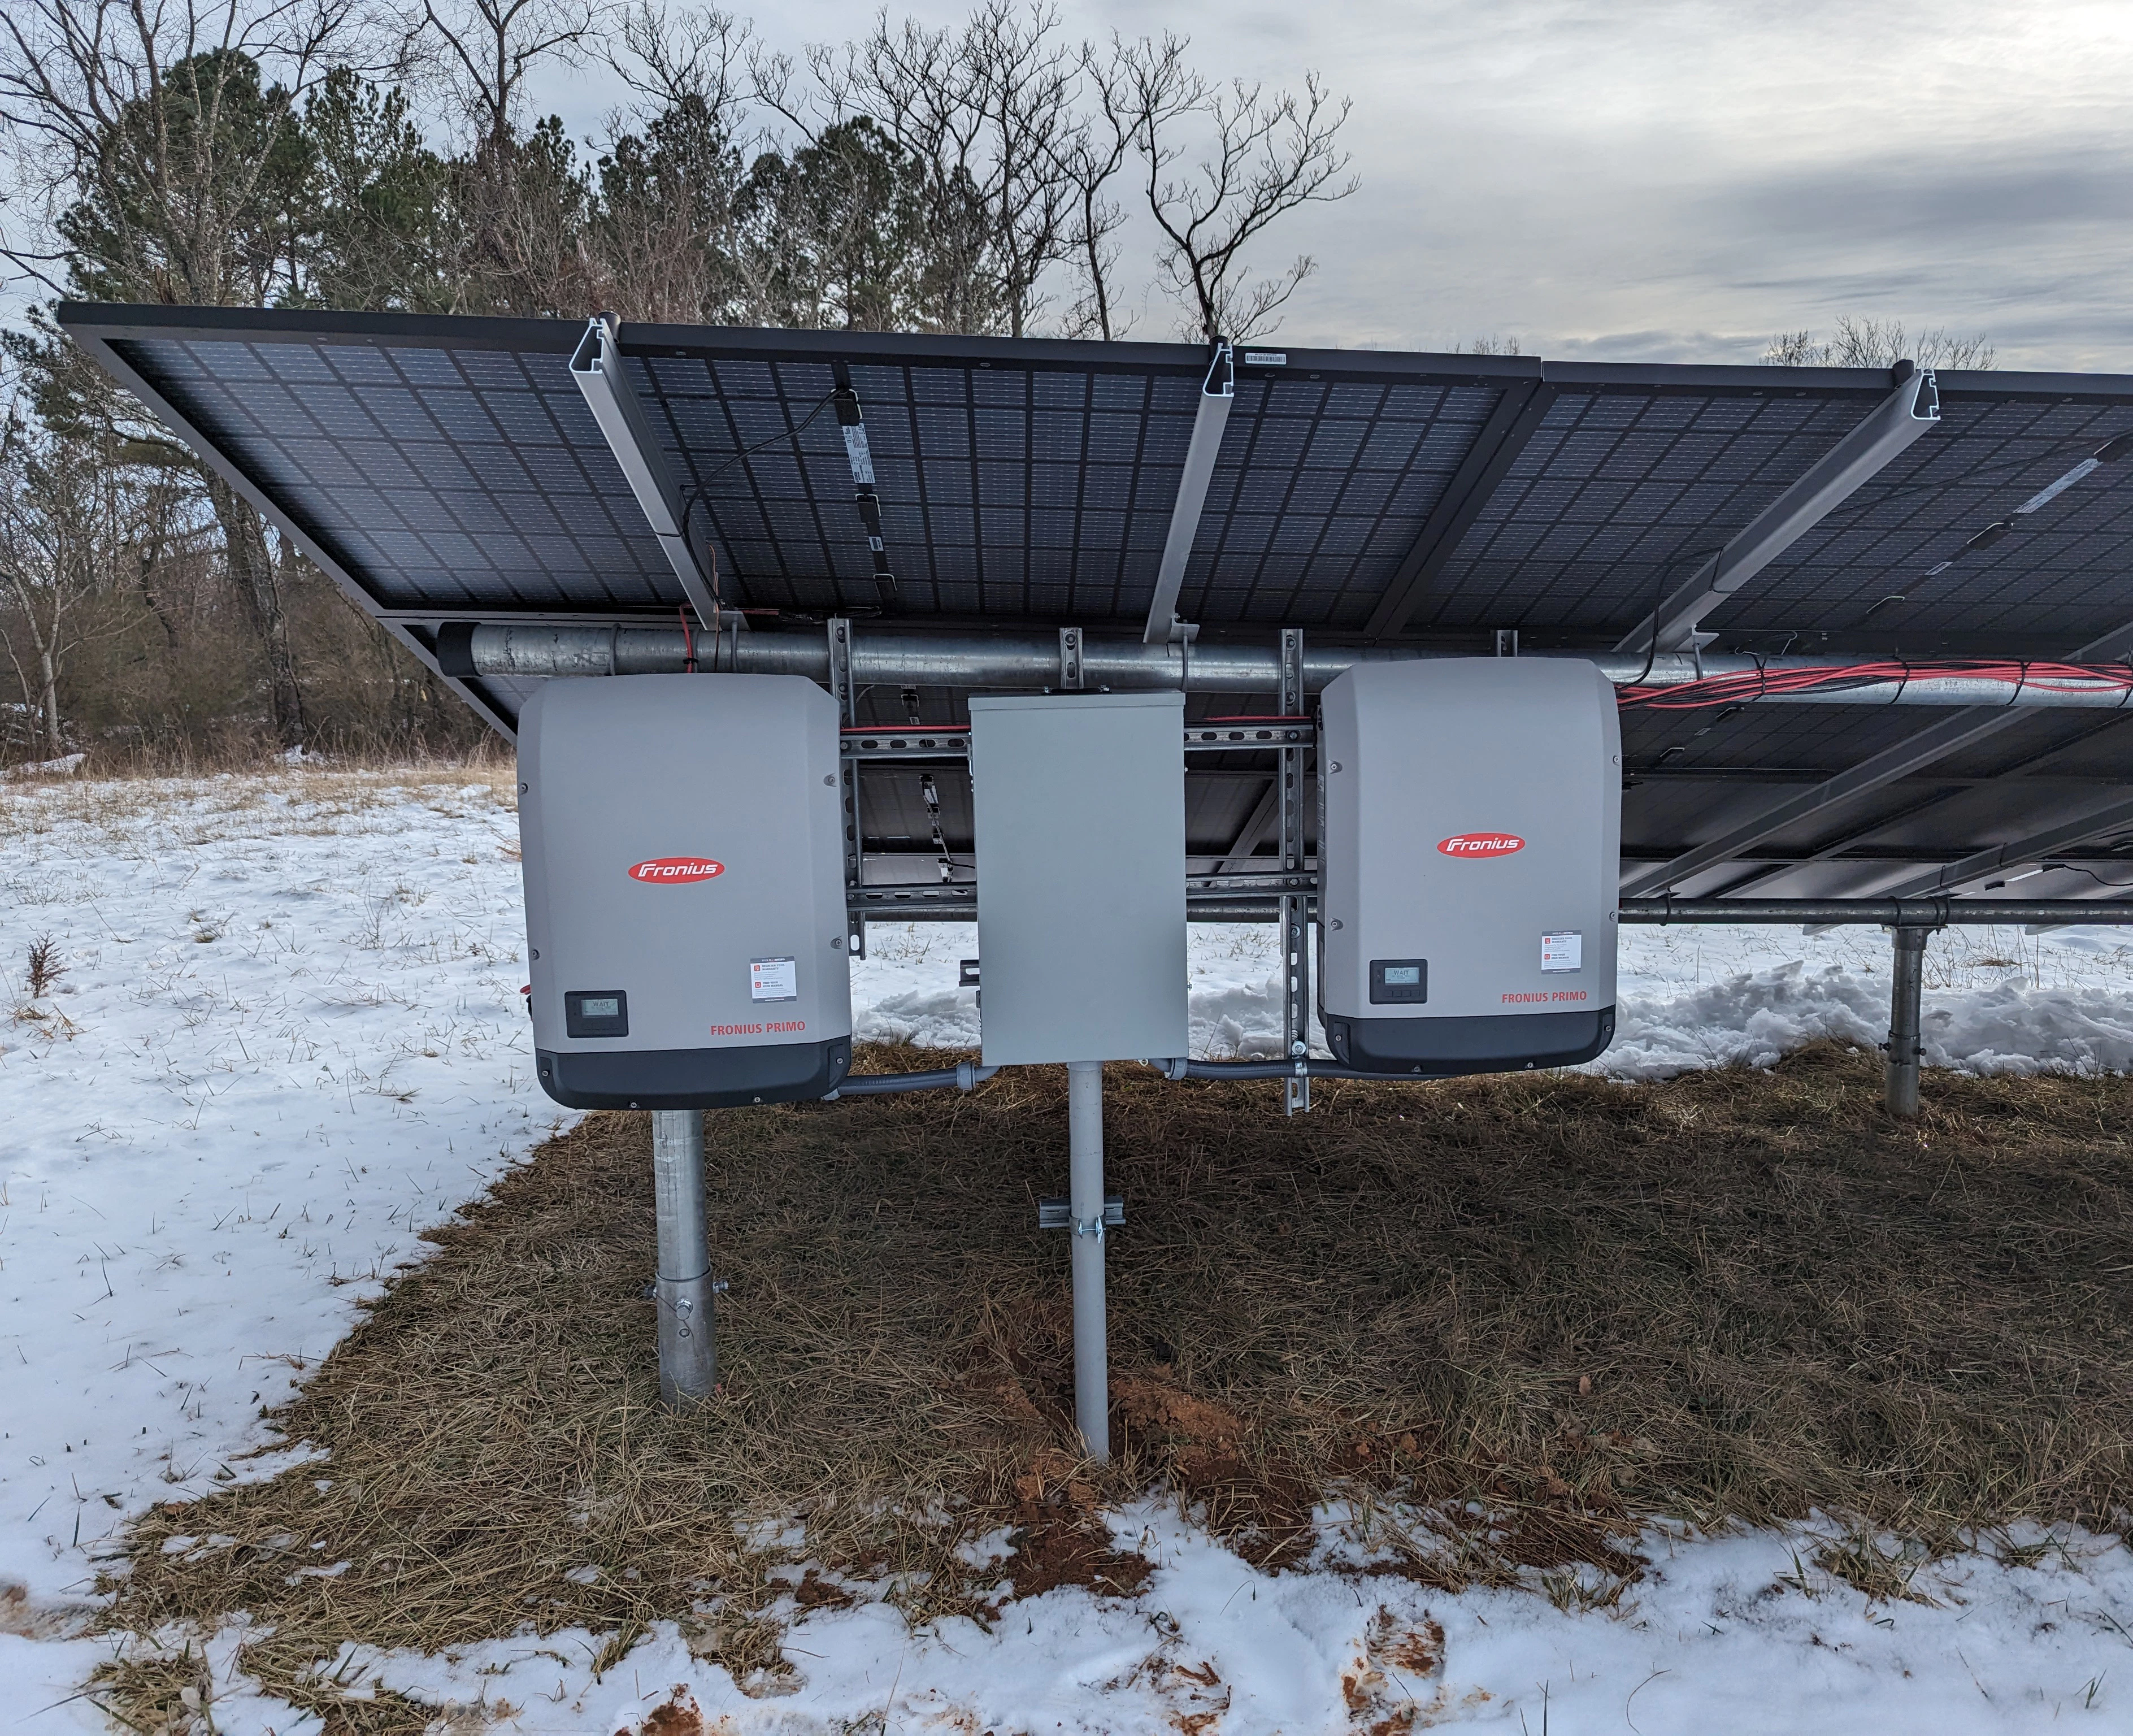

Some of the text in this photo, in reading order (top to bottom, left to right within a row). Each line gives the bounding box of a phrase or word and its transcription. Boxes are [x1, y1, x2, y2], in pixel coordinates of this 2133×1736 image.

[1446, 837, 1520, 852] Fronius
[638, 862, 718, 877] Fronius
[1502, 991, 1587, 1004] FRONIUS PRIMO
[710, 1021, 806, 1036] FRONIUS PRIMO
